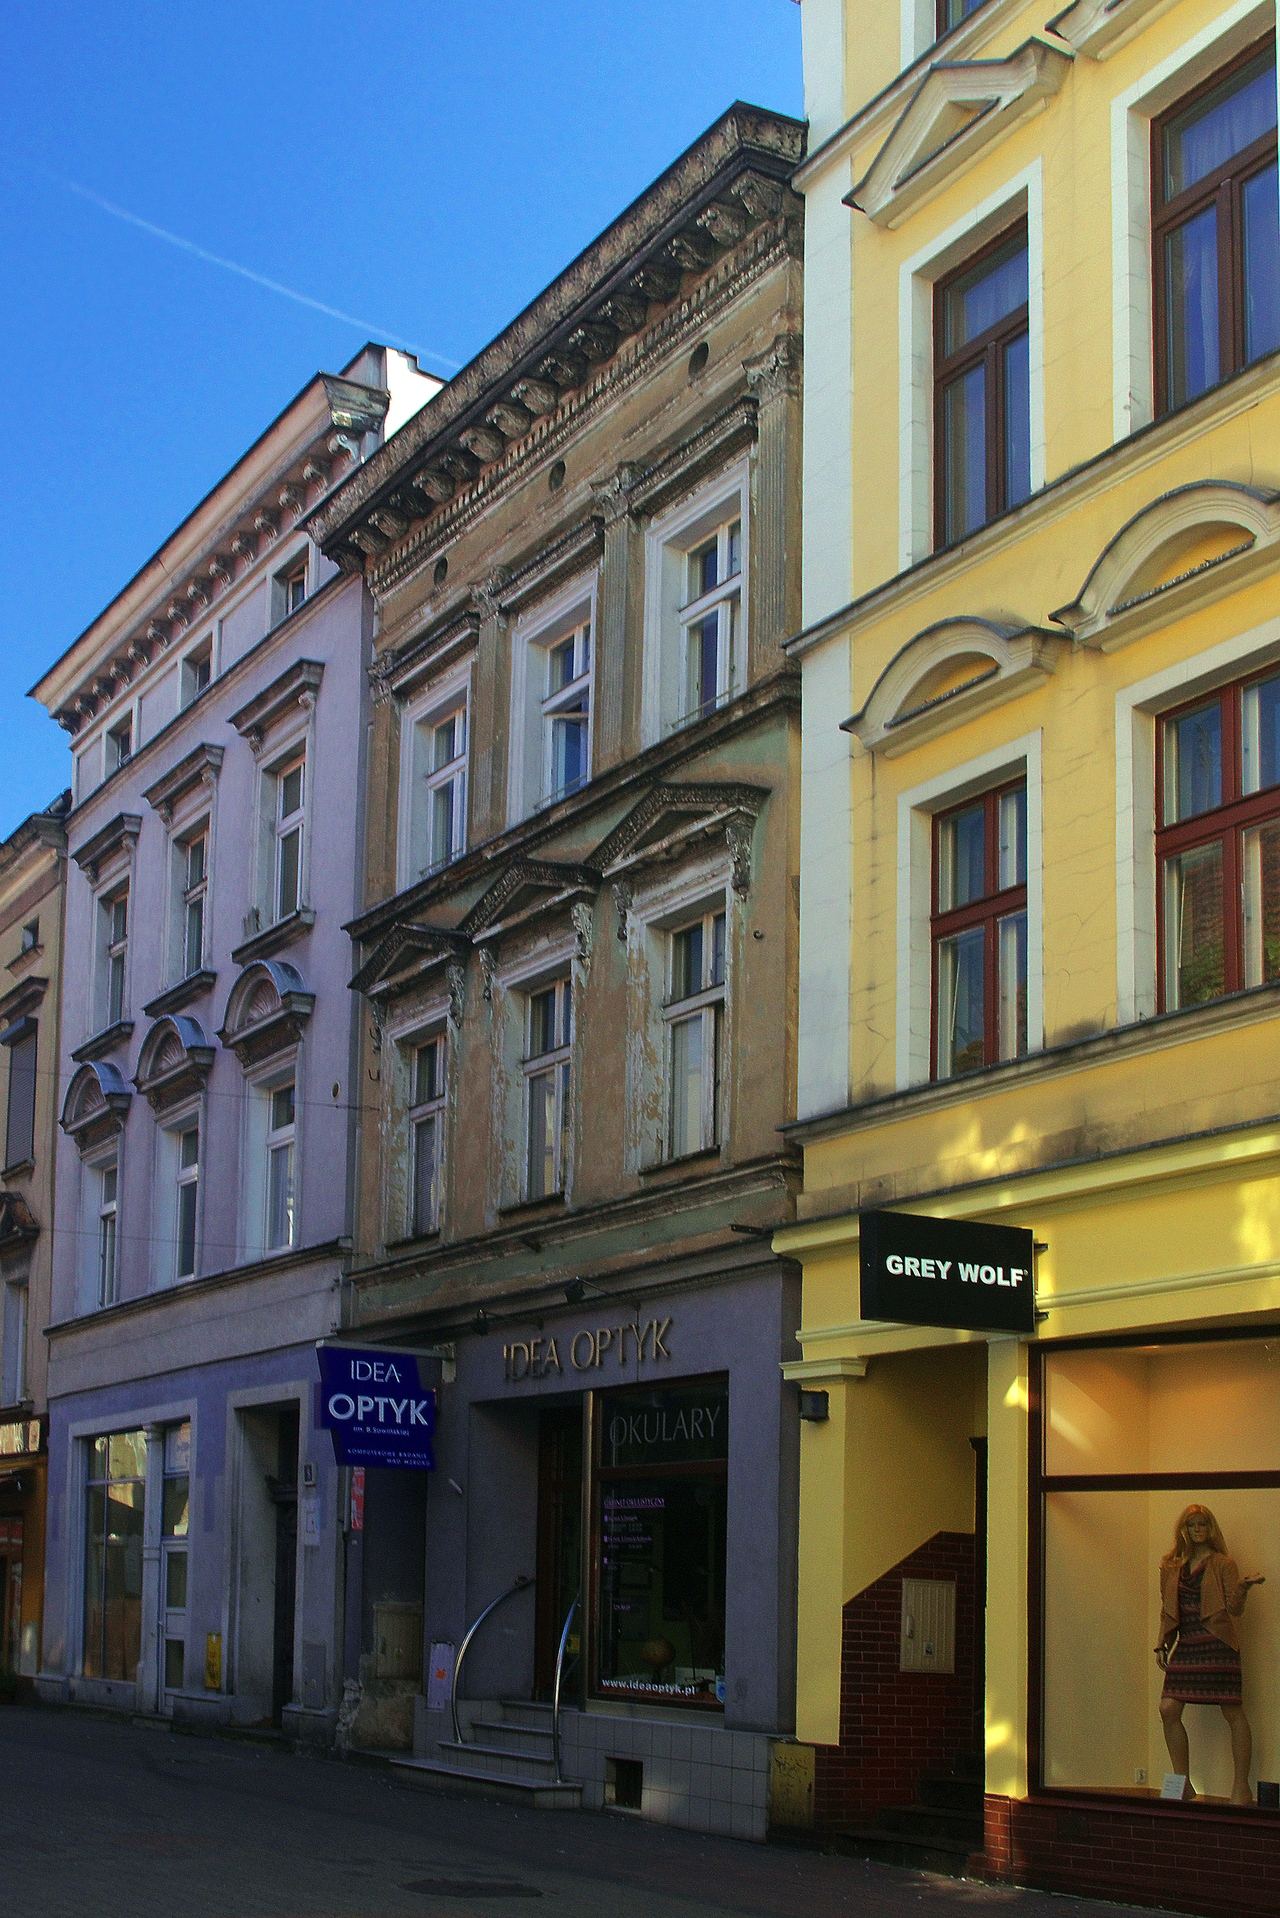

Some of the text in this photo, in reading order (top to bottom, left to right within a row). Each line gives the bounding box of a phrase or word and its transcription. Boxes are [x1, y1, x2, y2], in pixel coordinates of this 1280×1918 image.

[885, 1254, 1024, 1287] GREY WOLF
[502, 1315, 673, 1380] IDEA OPTYK
[350, 1359, 402, 1383] IDEA
[328, 1393, 429, 1426] OPTYK
[609, 1405, 720, 1446] OKULARY
[601, 1679, 696, 1696] www.ideaoptyk.pl
